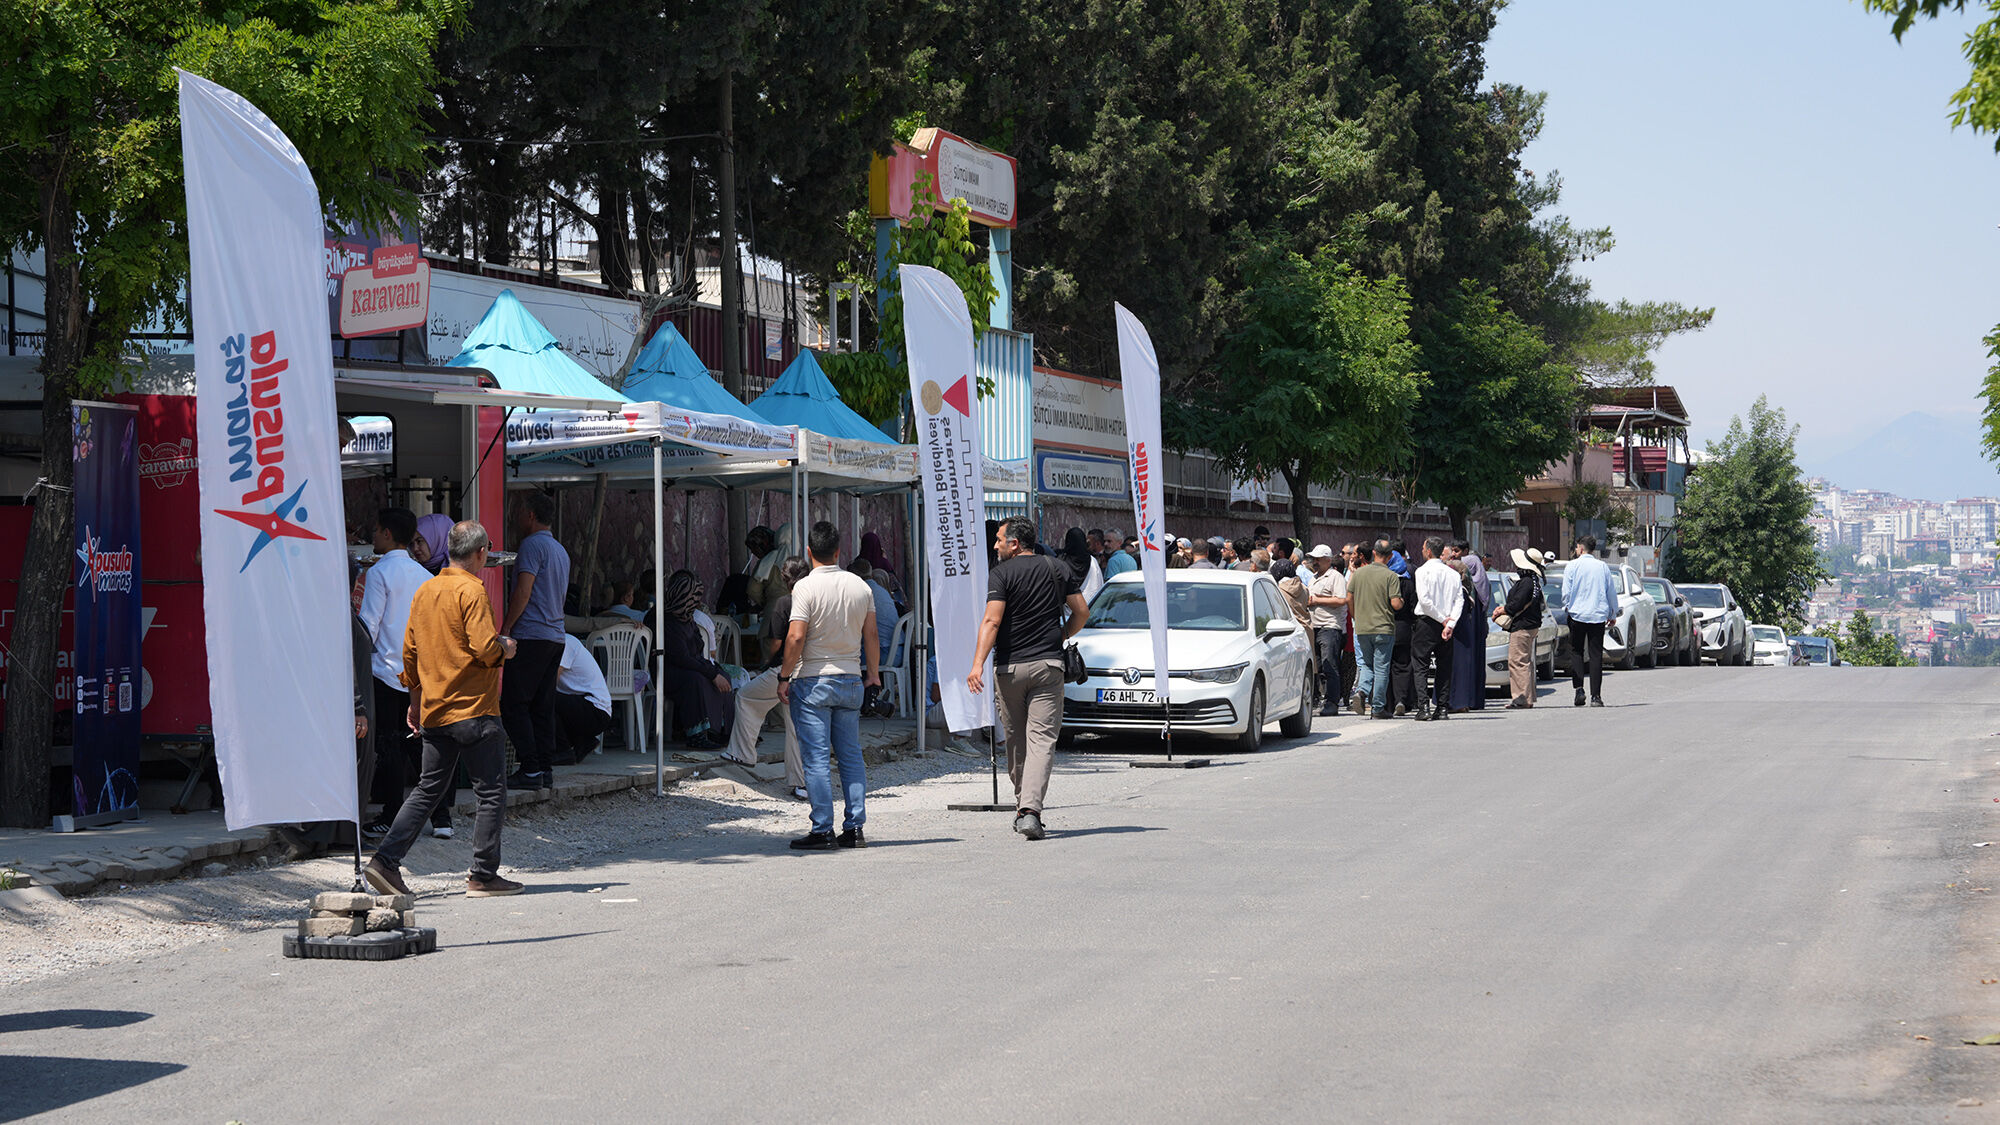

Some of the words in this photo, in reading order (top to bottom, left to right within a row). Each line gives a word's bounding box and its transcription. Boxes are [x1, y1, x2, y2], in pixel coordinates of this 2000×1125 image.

[377, 252, 414, 271] büyükşehir
[1051, 473, 1057, 487] 5
[1058, 470, 1081, 489] NİSAN
[1082, 475, 1123, 491] ORTAOKULU
[96, 544, 133, 583] pusula
[1103, 691, 1116, 702] 46
[1119, 691, 1138, 702] AHL
